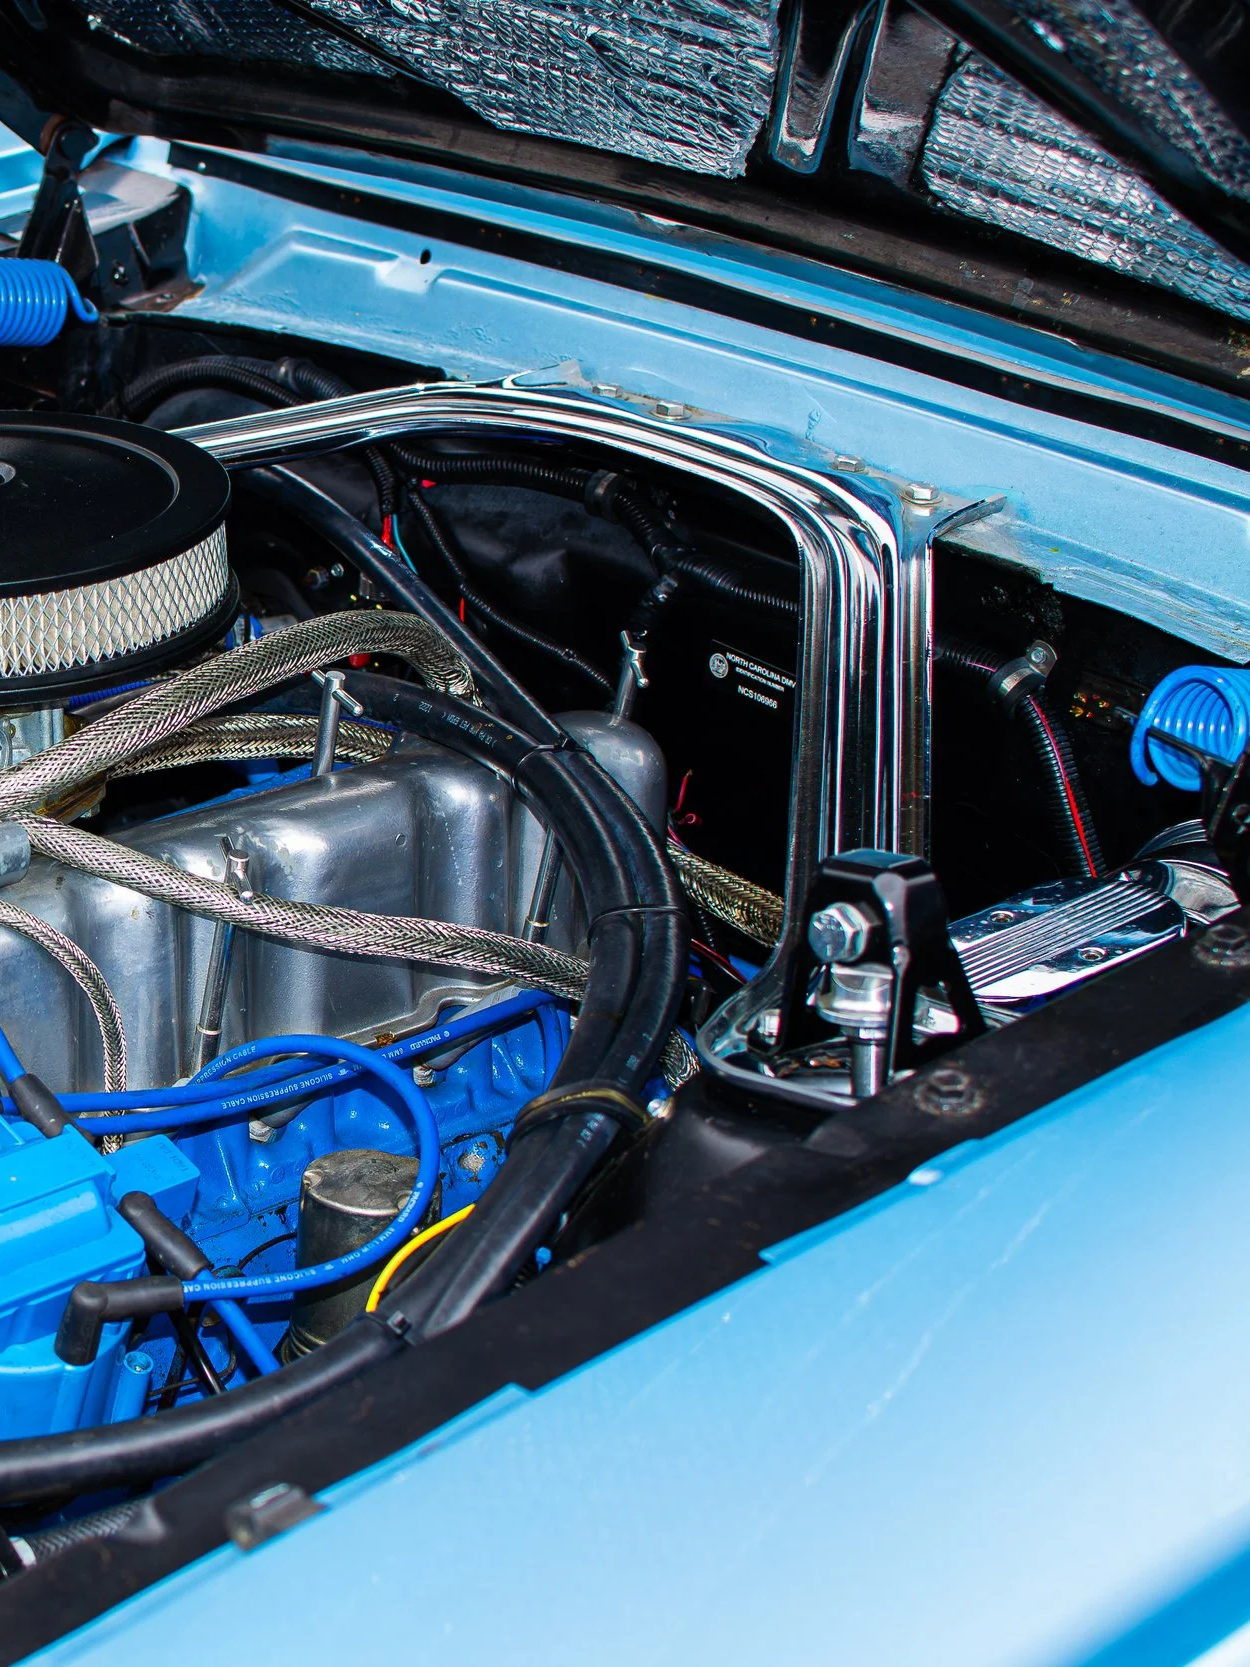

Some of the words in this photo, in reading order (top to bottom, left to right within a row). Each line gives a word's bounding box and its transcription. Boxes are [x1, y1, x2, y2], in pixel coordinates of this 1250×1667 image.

[726, 652, 748, 668] NORTH
[749, 663, 781, 682] CAROLINA
[781, 676, 796, 688] DMV
[410, 1033, 441, 1051] PACKARD
[194, 1057, 232, 1085] PPRESSION
[233, 1045, 256, 1060] CABLE
[300, 1072, 333, 1090] SILICONE
[250, 1083, 299, 1104] SUPPRESSION
[221, 1096, 247, 1110] CABLE
[397, 1191, 420, 1223] PACKARD
[203, 1278, 272, 1291] SUPPRESSION
[273, 1269, 317, 1283] SILICONE
